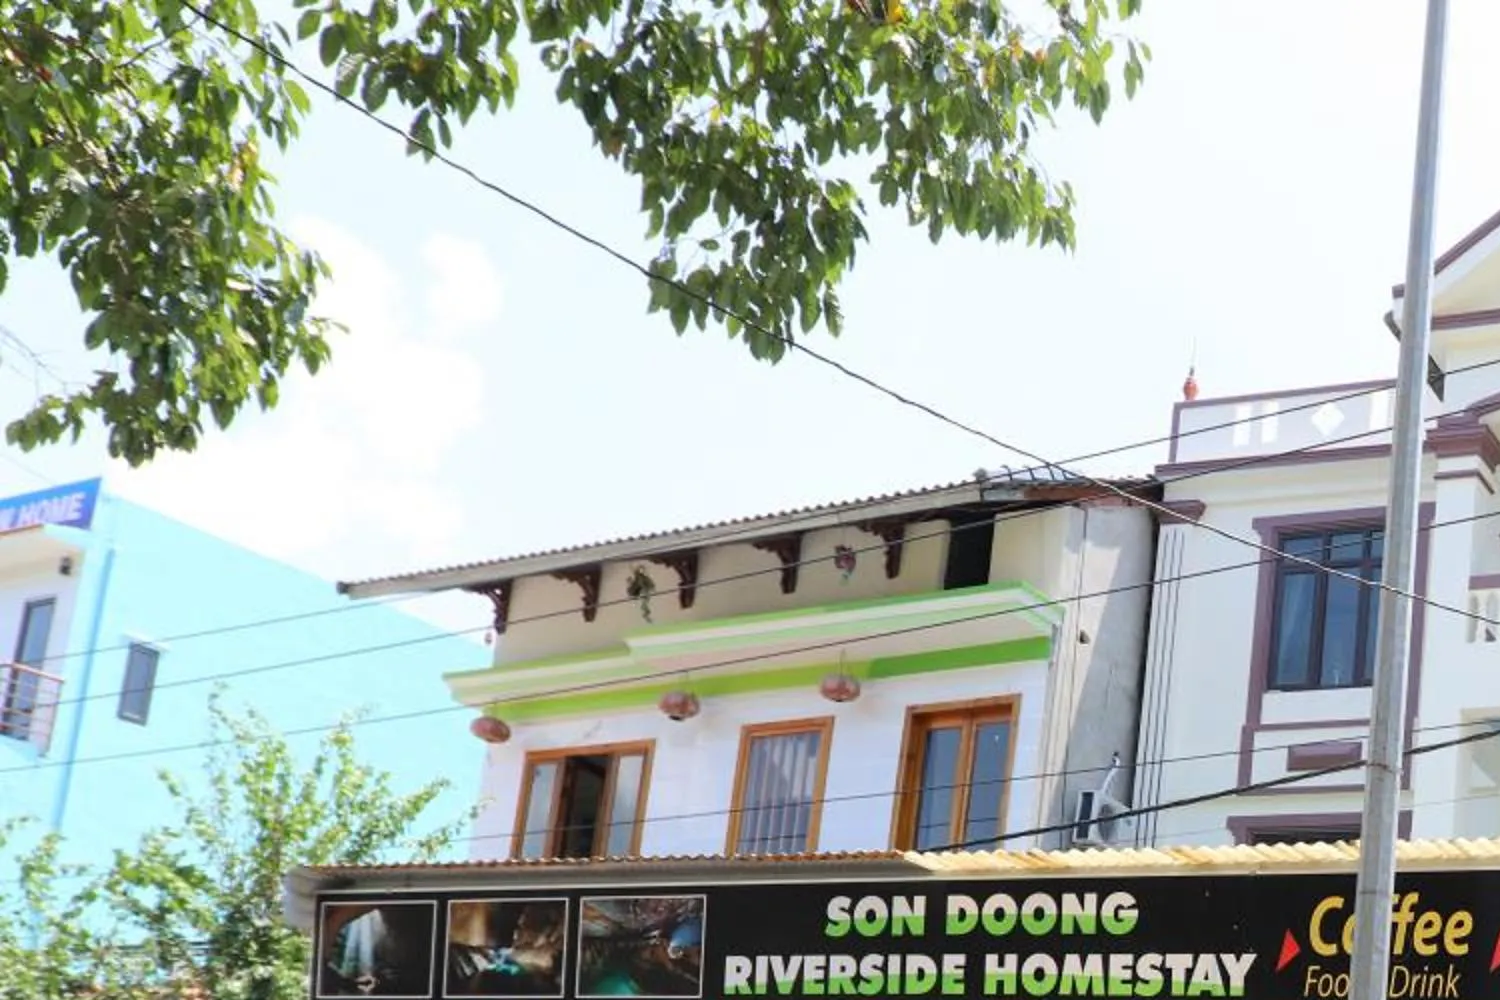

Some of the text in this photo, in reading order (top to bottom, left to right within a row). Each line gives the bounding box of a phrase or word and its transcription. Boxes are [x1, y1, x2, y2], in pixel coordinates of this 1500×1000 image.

[824, 892, 1139, 937] SON DOONG
[1309, 891, 1473, 957] Cfee
[723, 952, 1257, 997] RIVERSIDE HOMESTAY
[1303, 964, 1461, 999] Foo Drink
